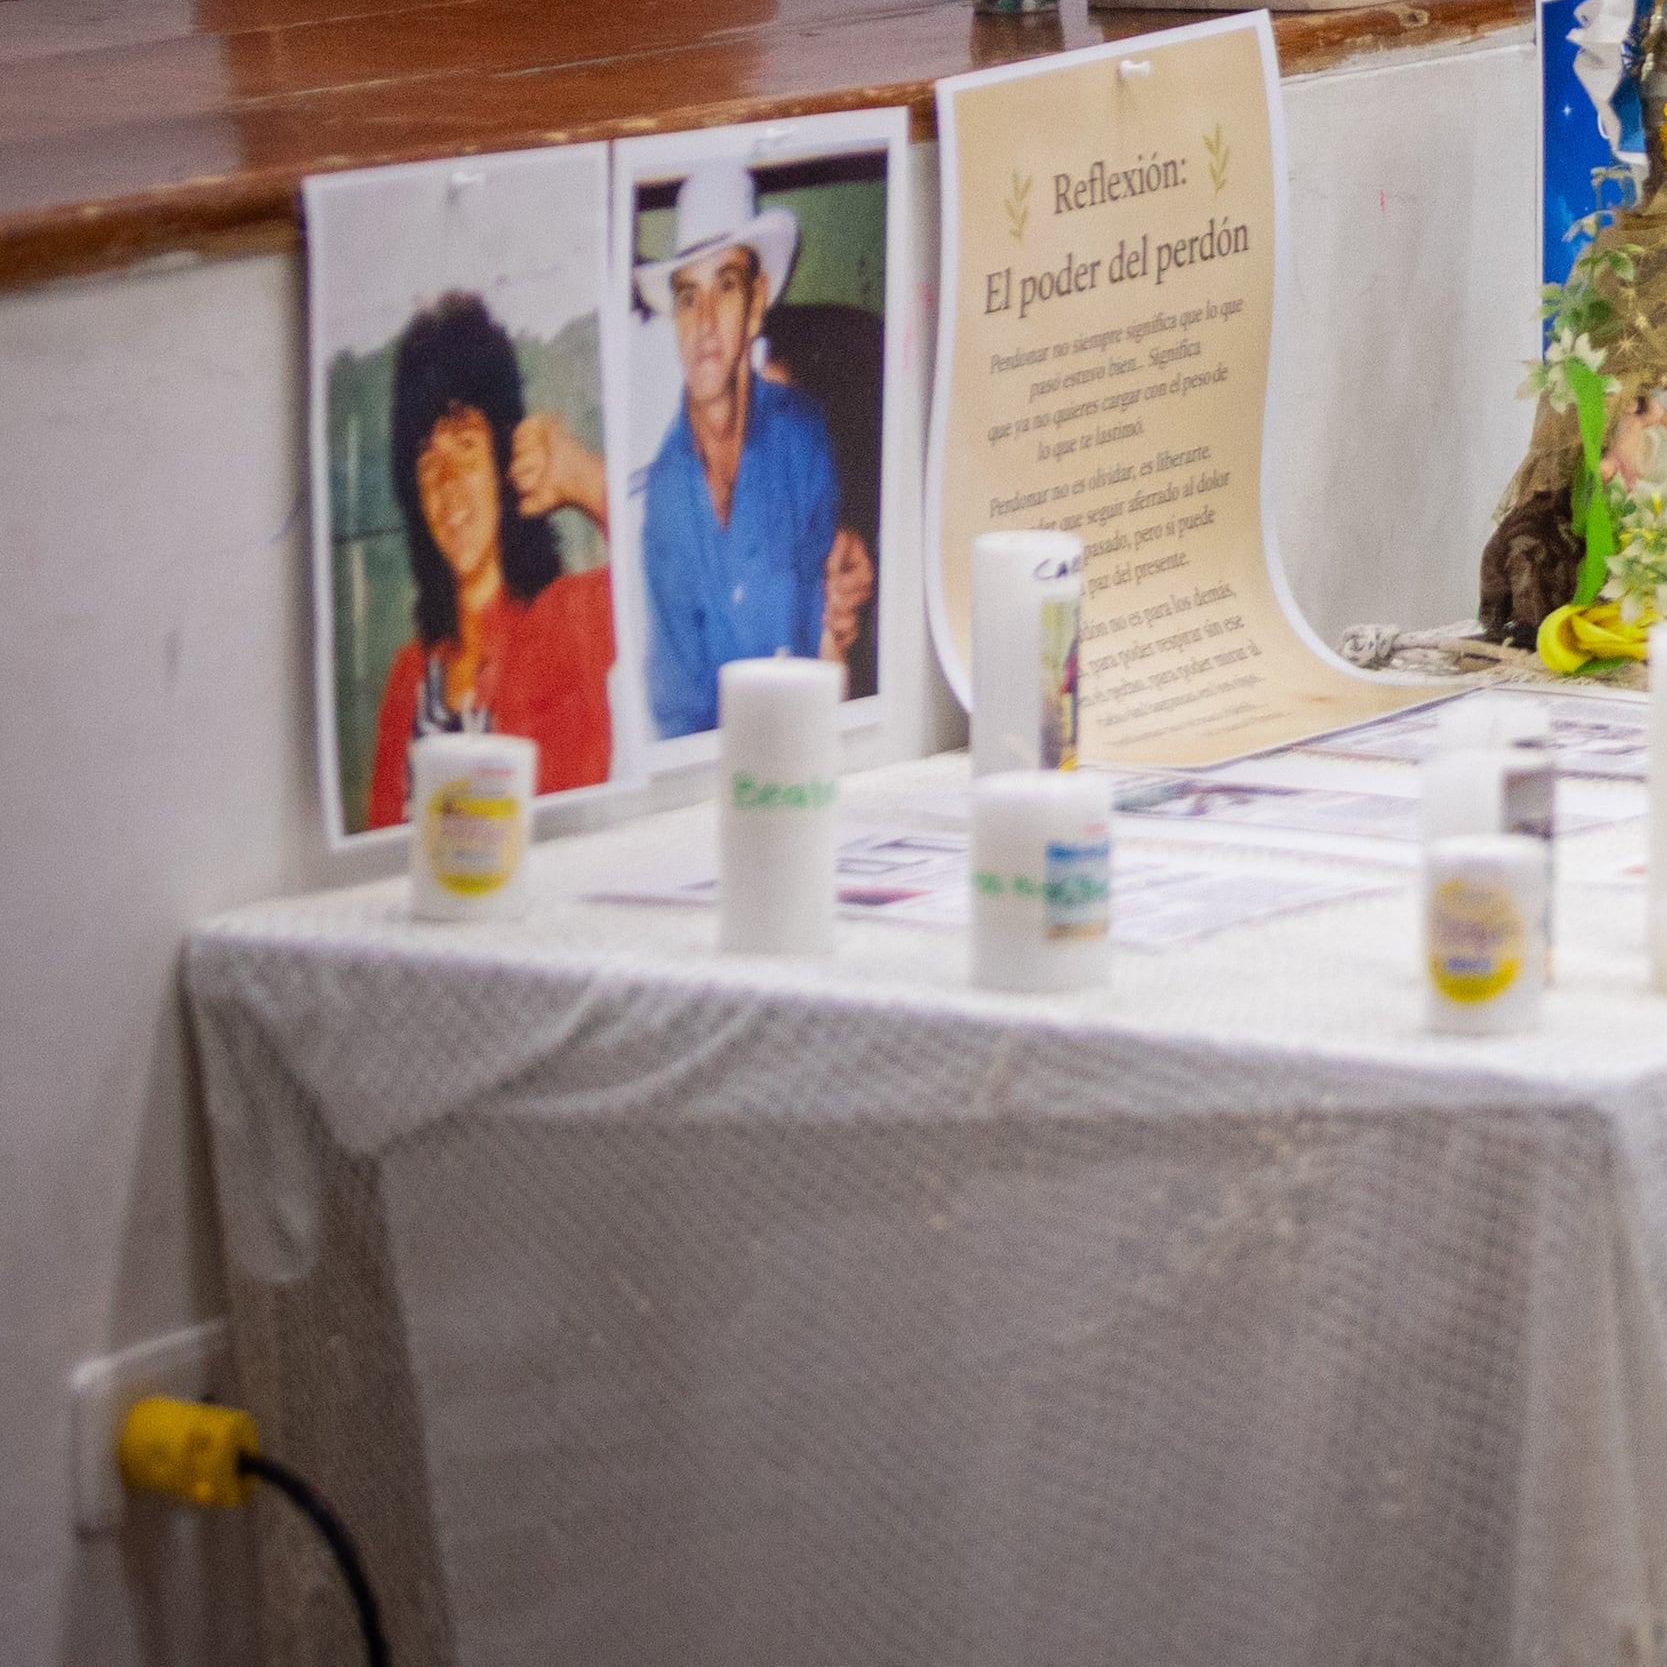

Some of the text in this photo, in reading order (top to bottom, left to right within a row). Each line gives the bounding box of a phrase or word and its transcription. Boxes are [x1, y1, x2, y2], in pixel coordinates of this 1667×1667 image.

[1054, 151, 1187, 215] Reflexión:
[984, 216, 1250, 319] El poder del perdón
[990, 346, 1049, 375] Perdonar
[1052, 342, 1070, 357] no
[1179, 308, 1203, 334] que
[1206, 297, 1218, 320] lo
[1220, 297, 1245, 322] que
[1101, 388, 1142, 413] cargar
[1144, 381, 1168, 402] con
[1182, 371, 1212, 397] peso
[1213, 360, 1229, 383] de
[990, 489, 1049, 519] Perdonar
[1051, 483, 1069, 500] no
[1071, 477, 1087, 495] es
[1139, 459, 1154, 477] es
[1086, 499, 1124, 527] seguir
[1127, 481, 1181, 515] aferrado
[1182, 475, 1195, 497] al
[1196, 468, 1232, 495] dolor
[1134, 526, 1164, 551] pero
[1178, 504, 1216, 540] puede
